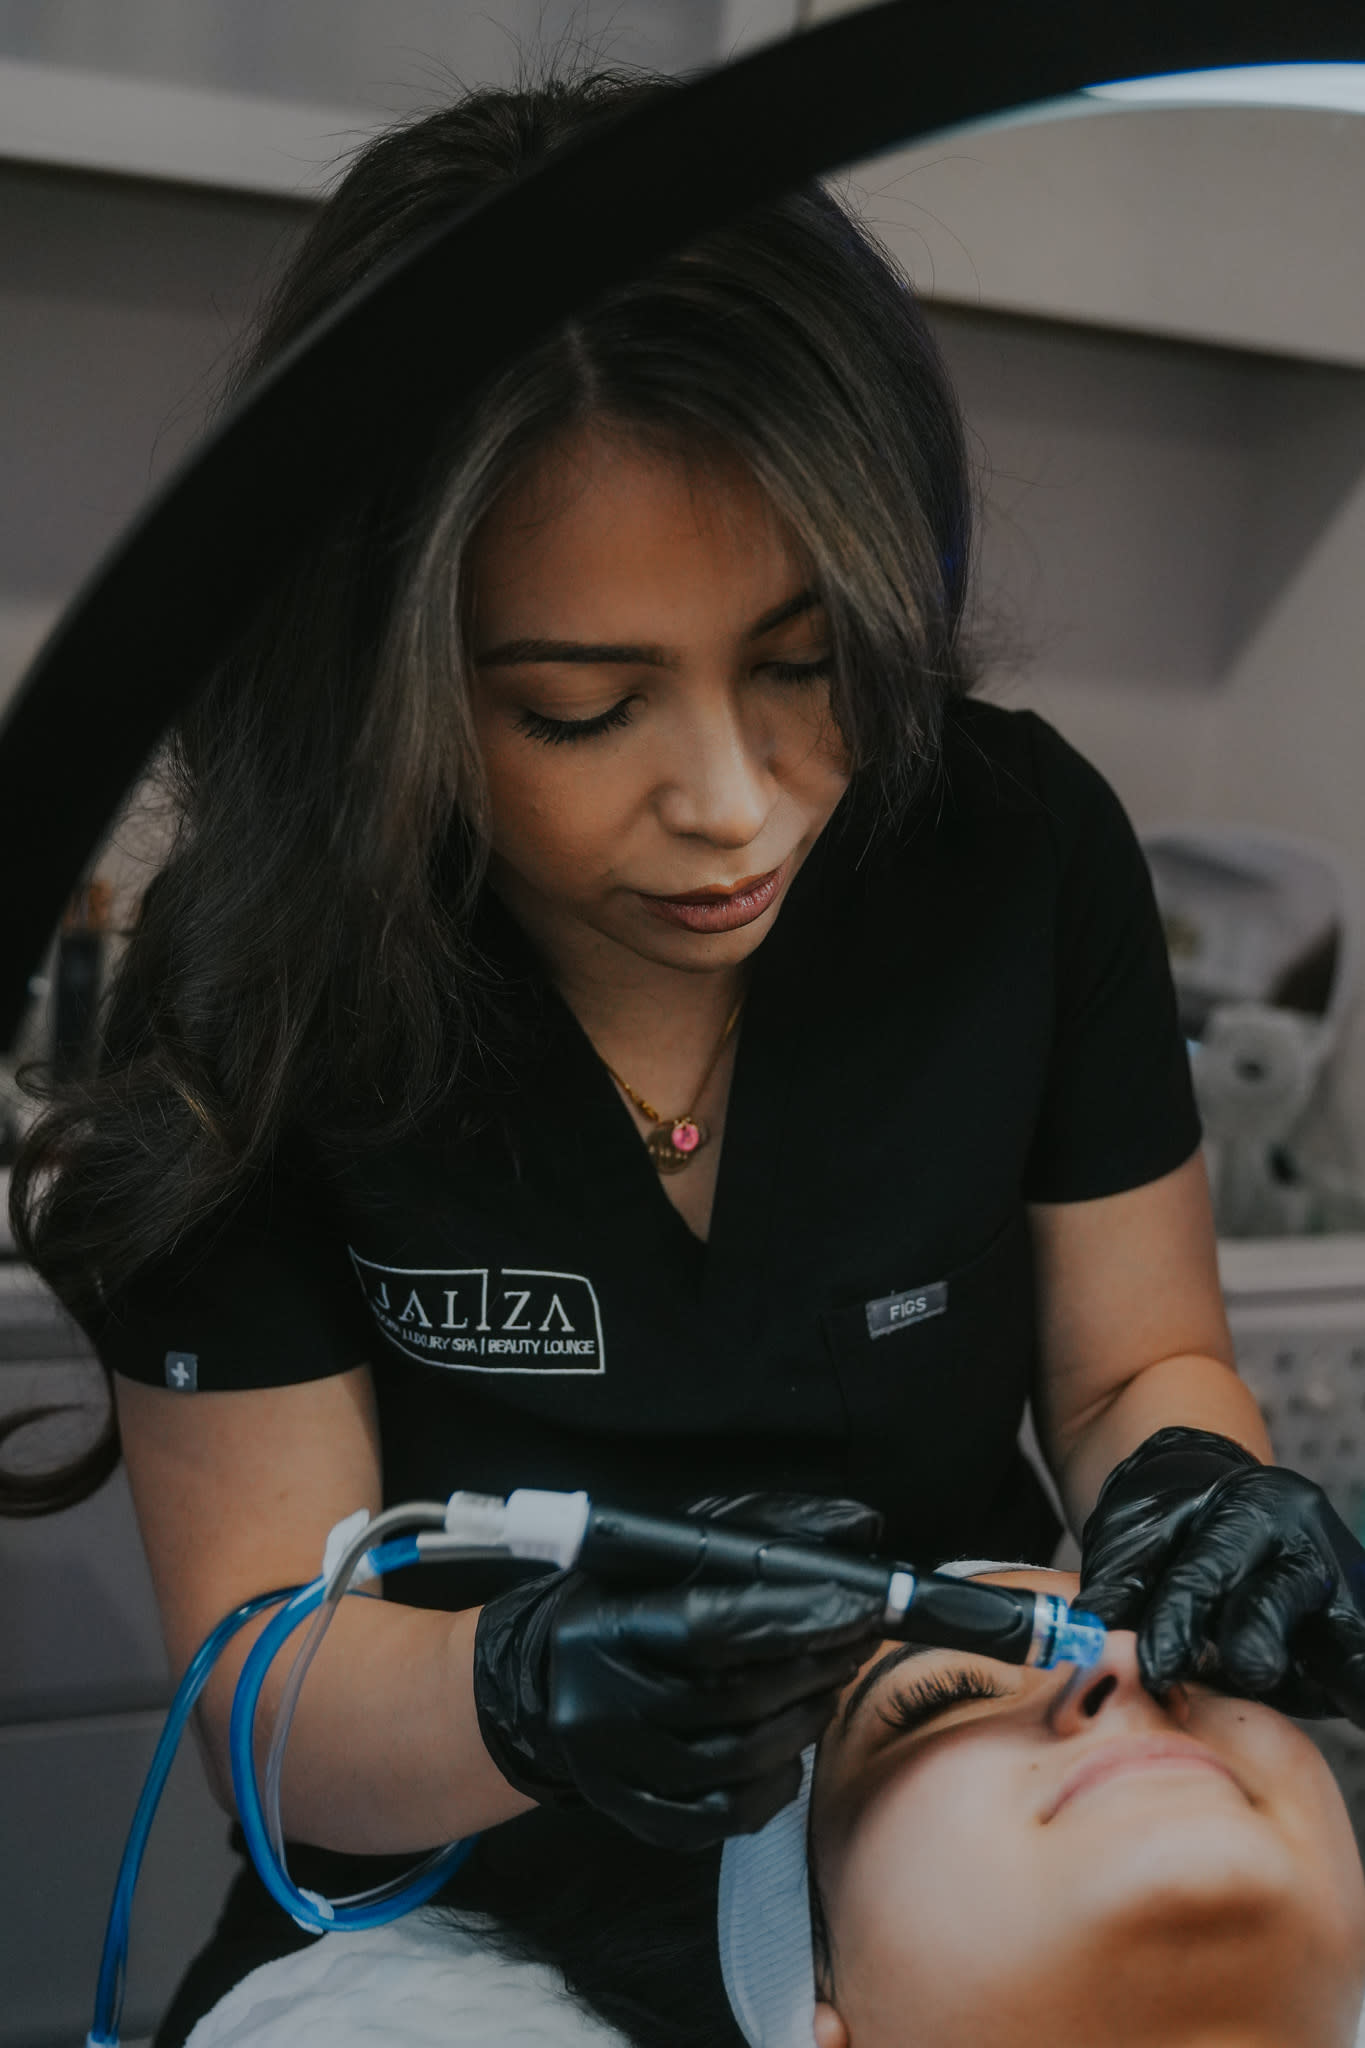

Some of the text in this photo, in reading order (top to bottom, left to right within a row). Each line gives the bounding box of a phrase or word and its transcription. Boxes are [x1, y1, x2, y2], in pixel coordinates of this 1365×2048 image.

[374, 1273, 576, 1332] JALIZA
[889, 1296, 927, 1321] FIGS
[451, 1337, 478, 1354] SPA
[487, 1339, 540, 1355] BEAUTY
[543, 1339, 595, 1355] LOUNGE
